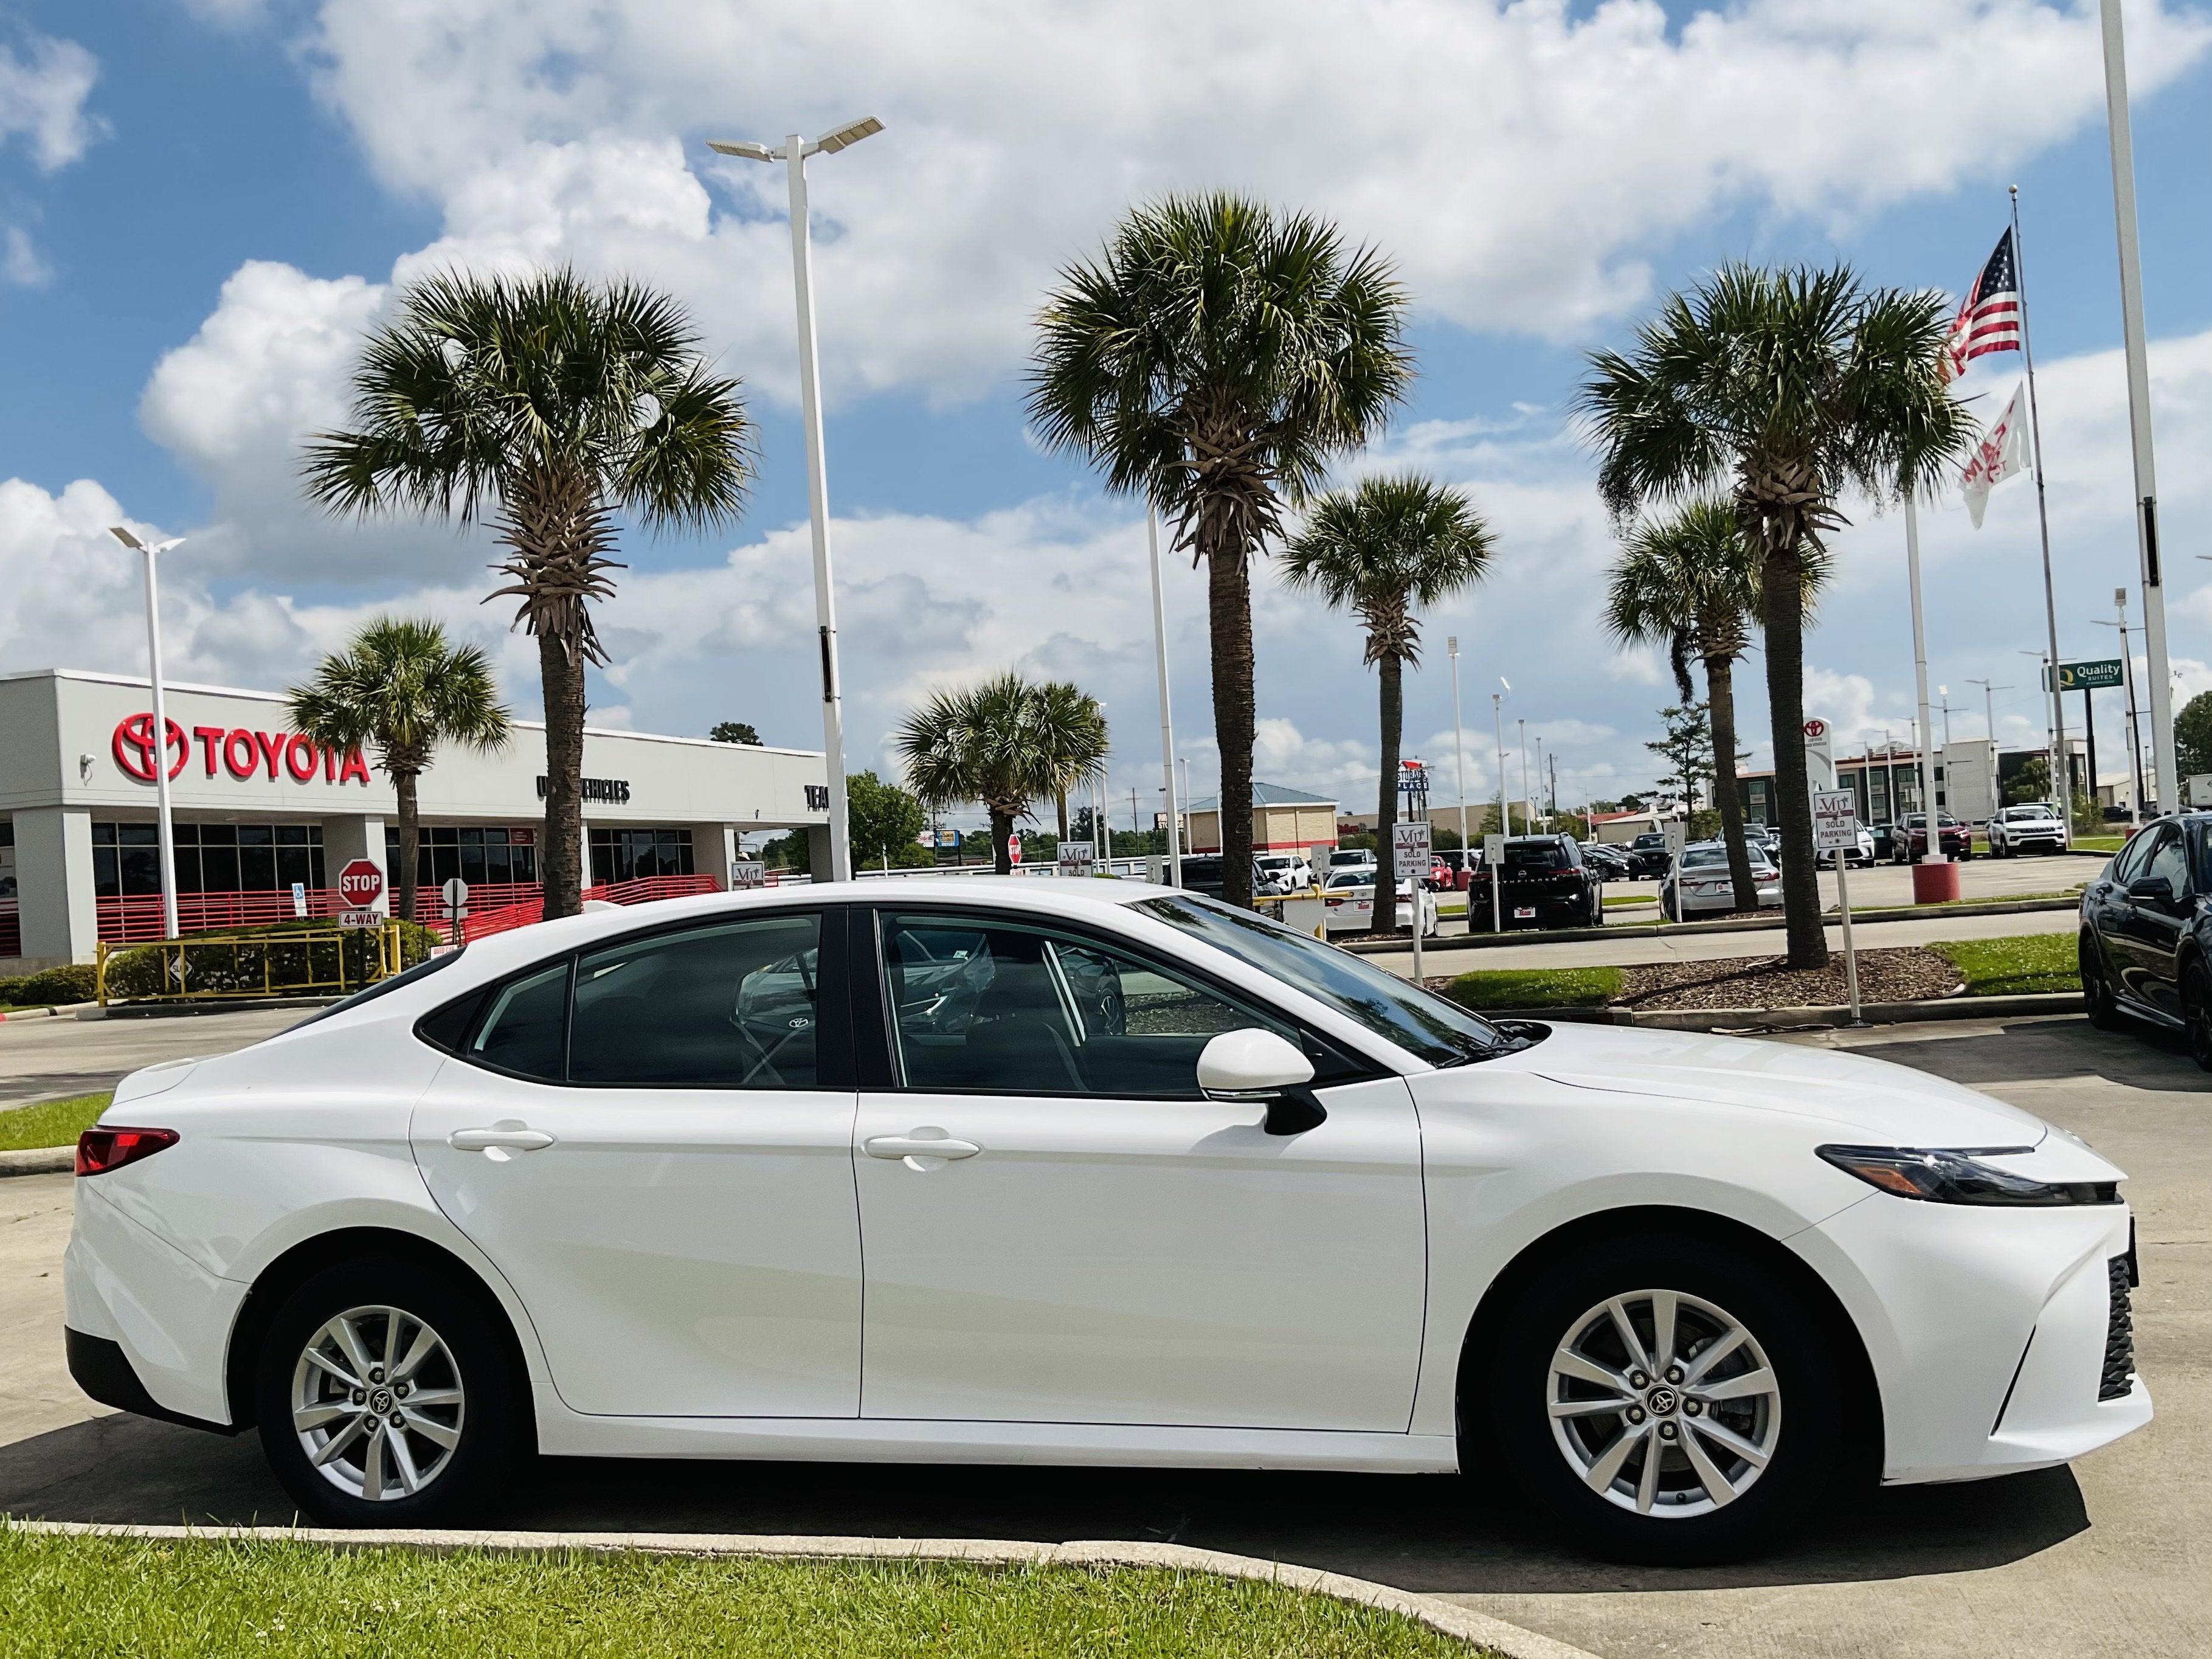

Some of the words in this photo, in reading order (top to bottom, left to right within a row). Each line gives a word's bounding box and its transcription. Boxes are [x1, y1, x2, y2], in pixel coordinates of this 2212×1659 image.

[2076, 664, 2120, 677] Quality
[581, 778, 630, 801] EHICLES
[804, 785, 829, 808] TEA
[1820, 830, 1852, 839] PARKING
[342, 875, 380, 892] STOP
[344, 914, 378, 924] 4-WAY
